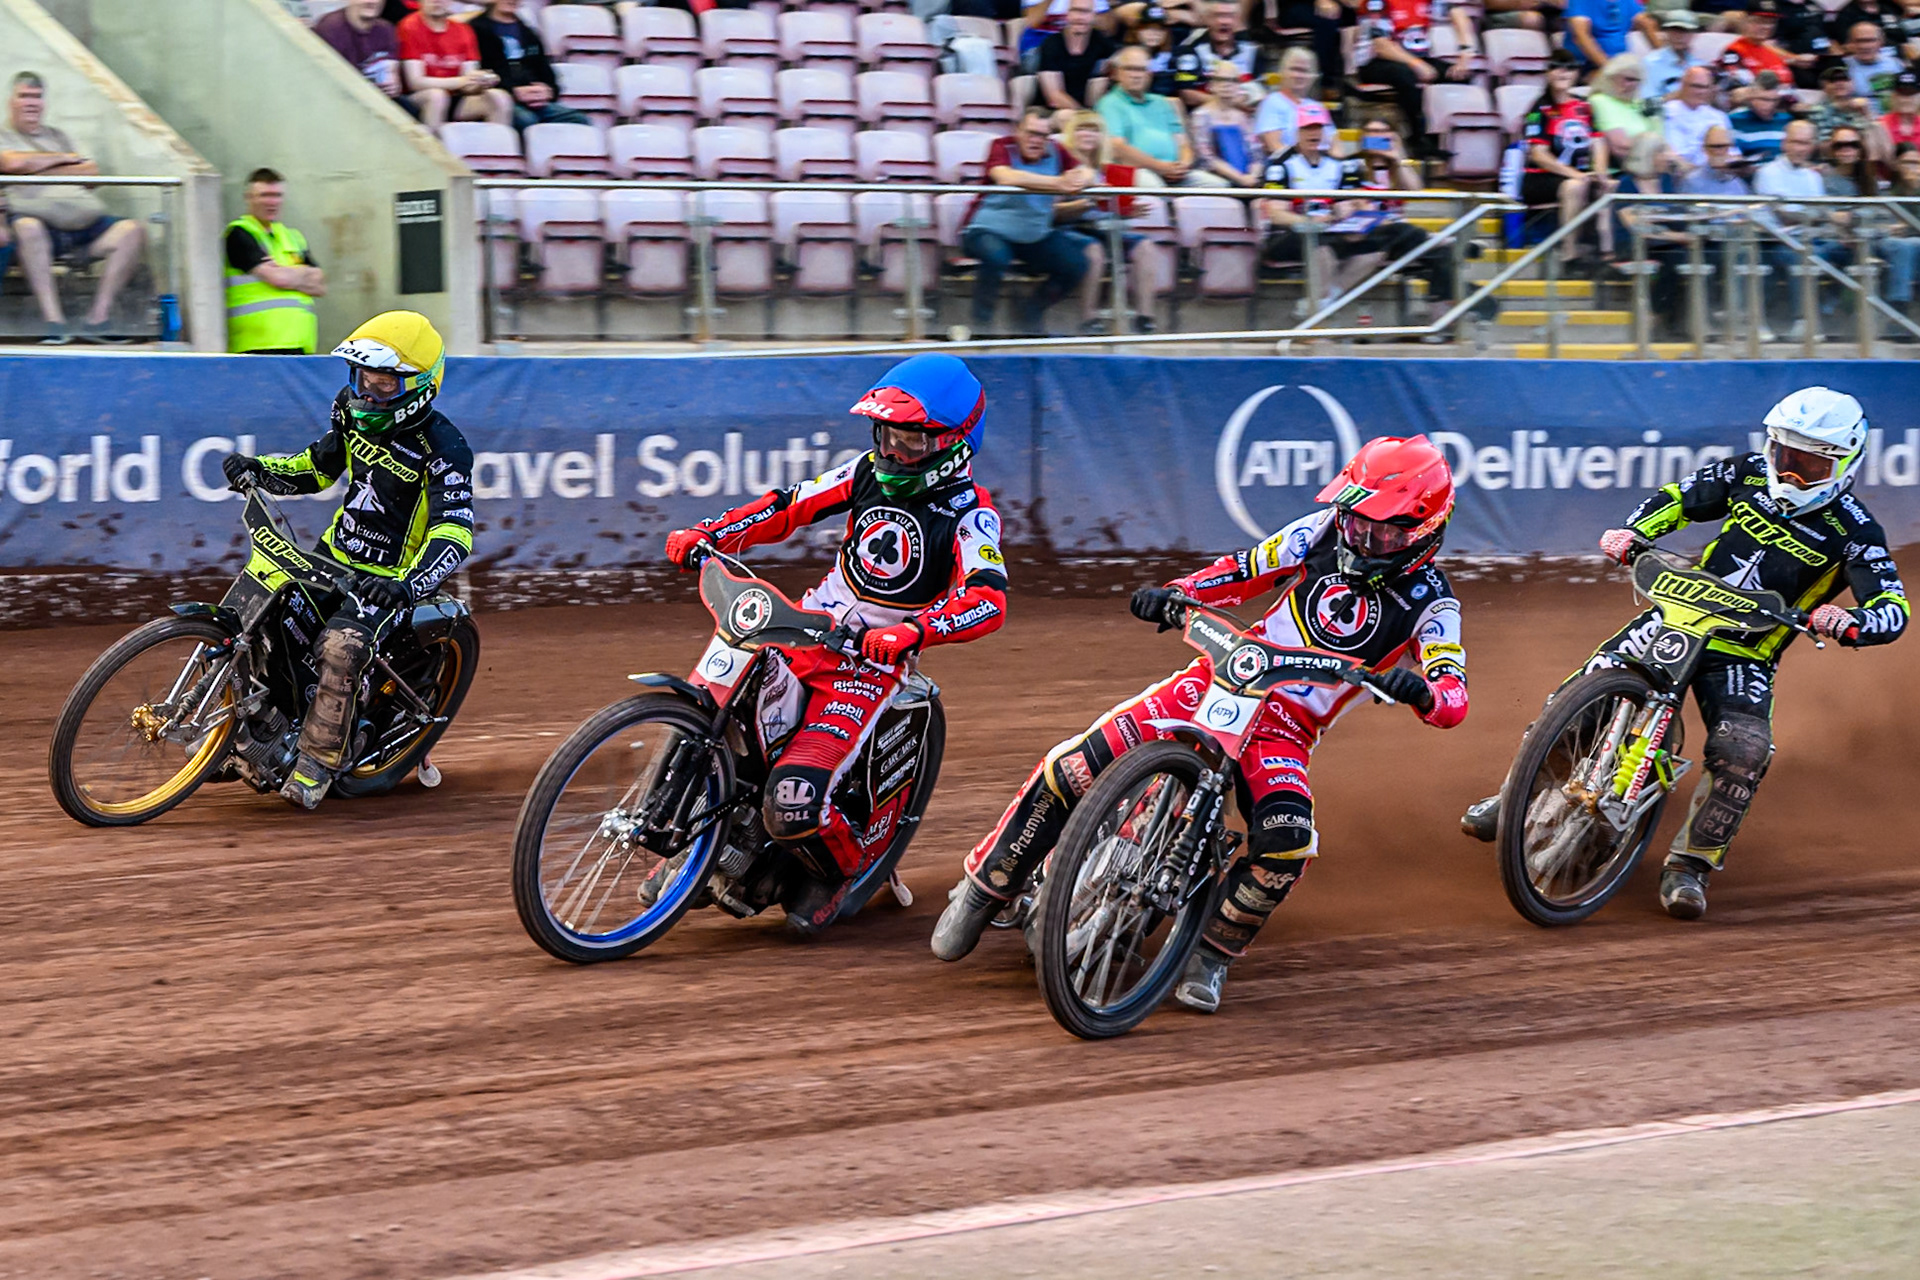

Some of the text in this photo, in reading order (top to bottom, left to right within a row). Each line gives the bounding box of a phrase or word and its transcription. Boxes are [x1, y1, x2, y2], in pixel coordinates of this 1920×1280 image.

[472, 433, 616, 498] avel
[1239, 440, 1335, 487] ATPI
[860, 511, 920, 559] BELLE VUE ACES
[1368, 599, 1379, 626] ACES
[833, 679, 883, 695] Richard
[823, 700, 865, 719] Mobil
[1212, 706, 1234, 720] ATPI
[775, 811, 810, 823] BOLL
